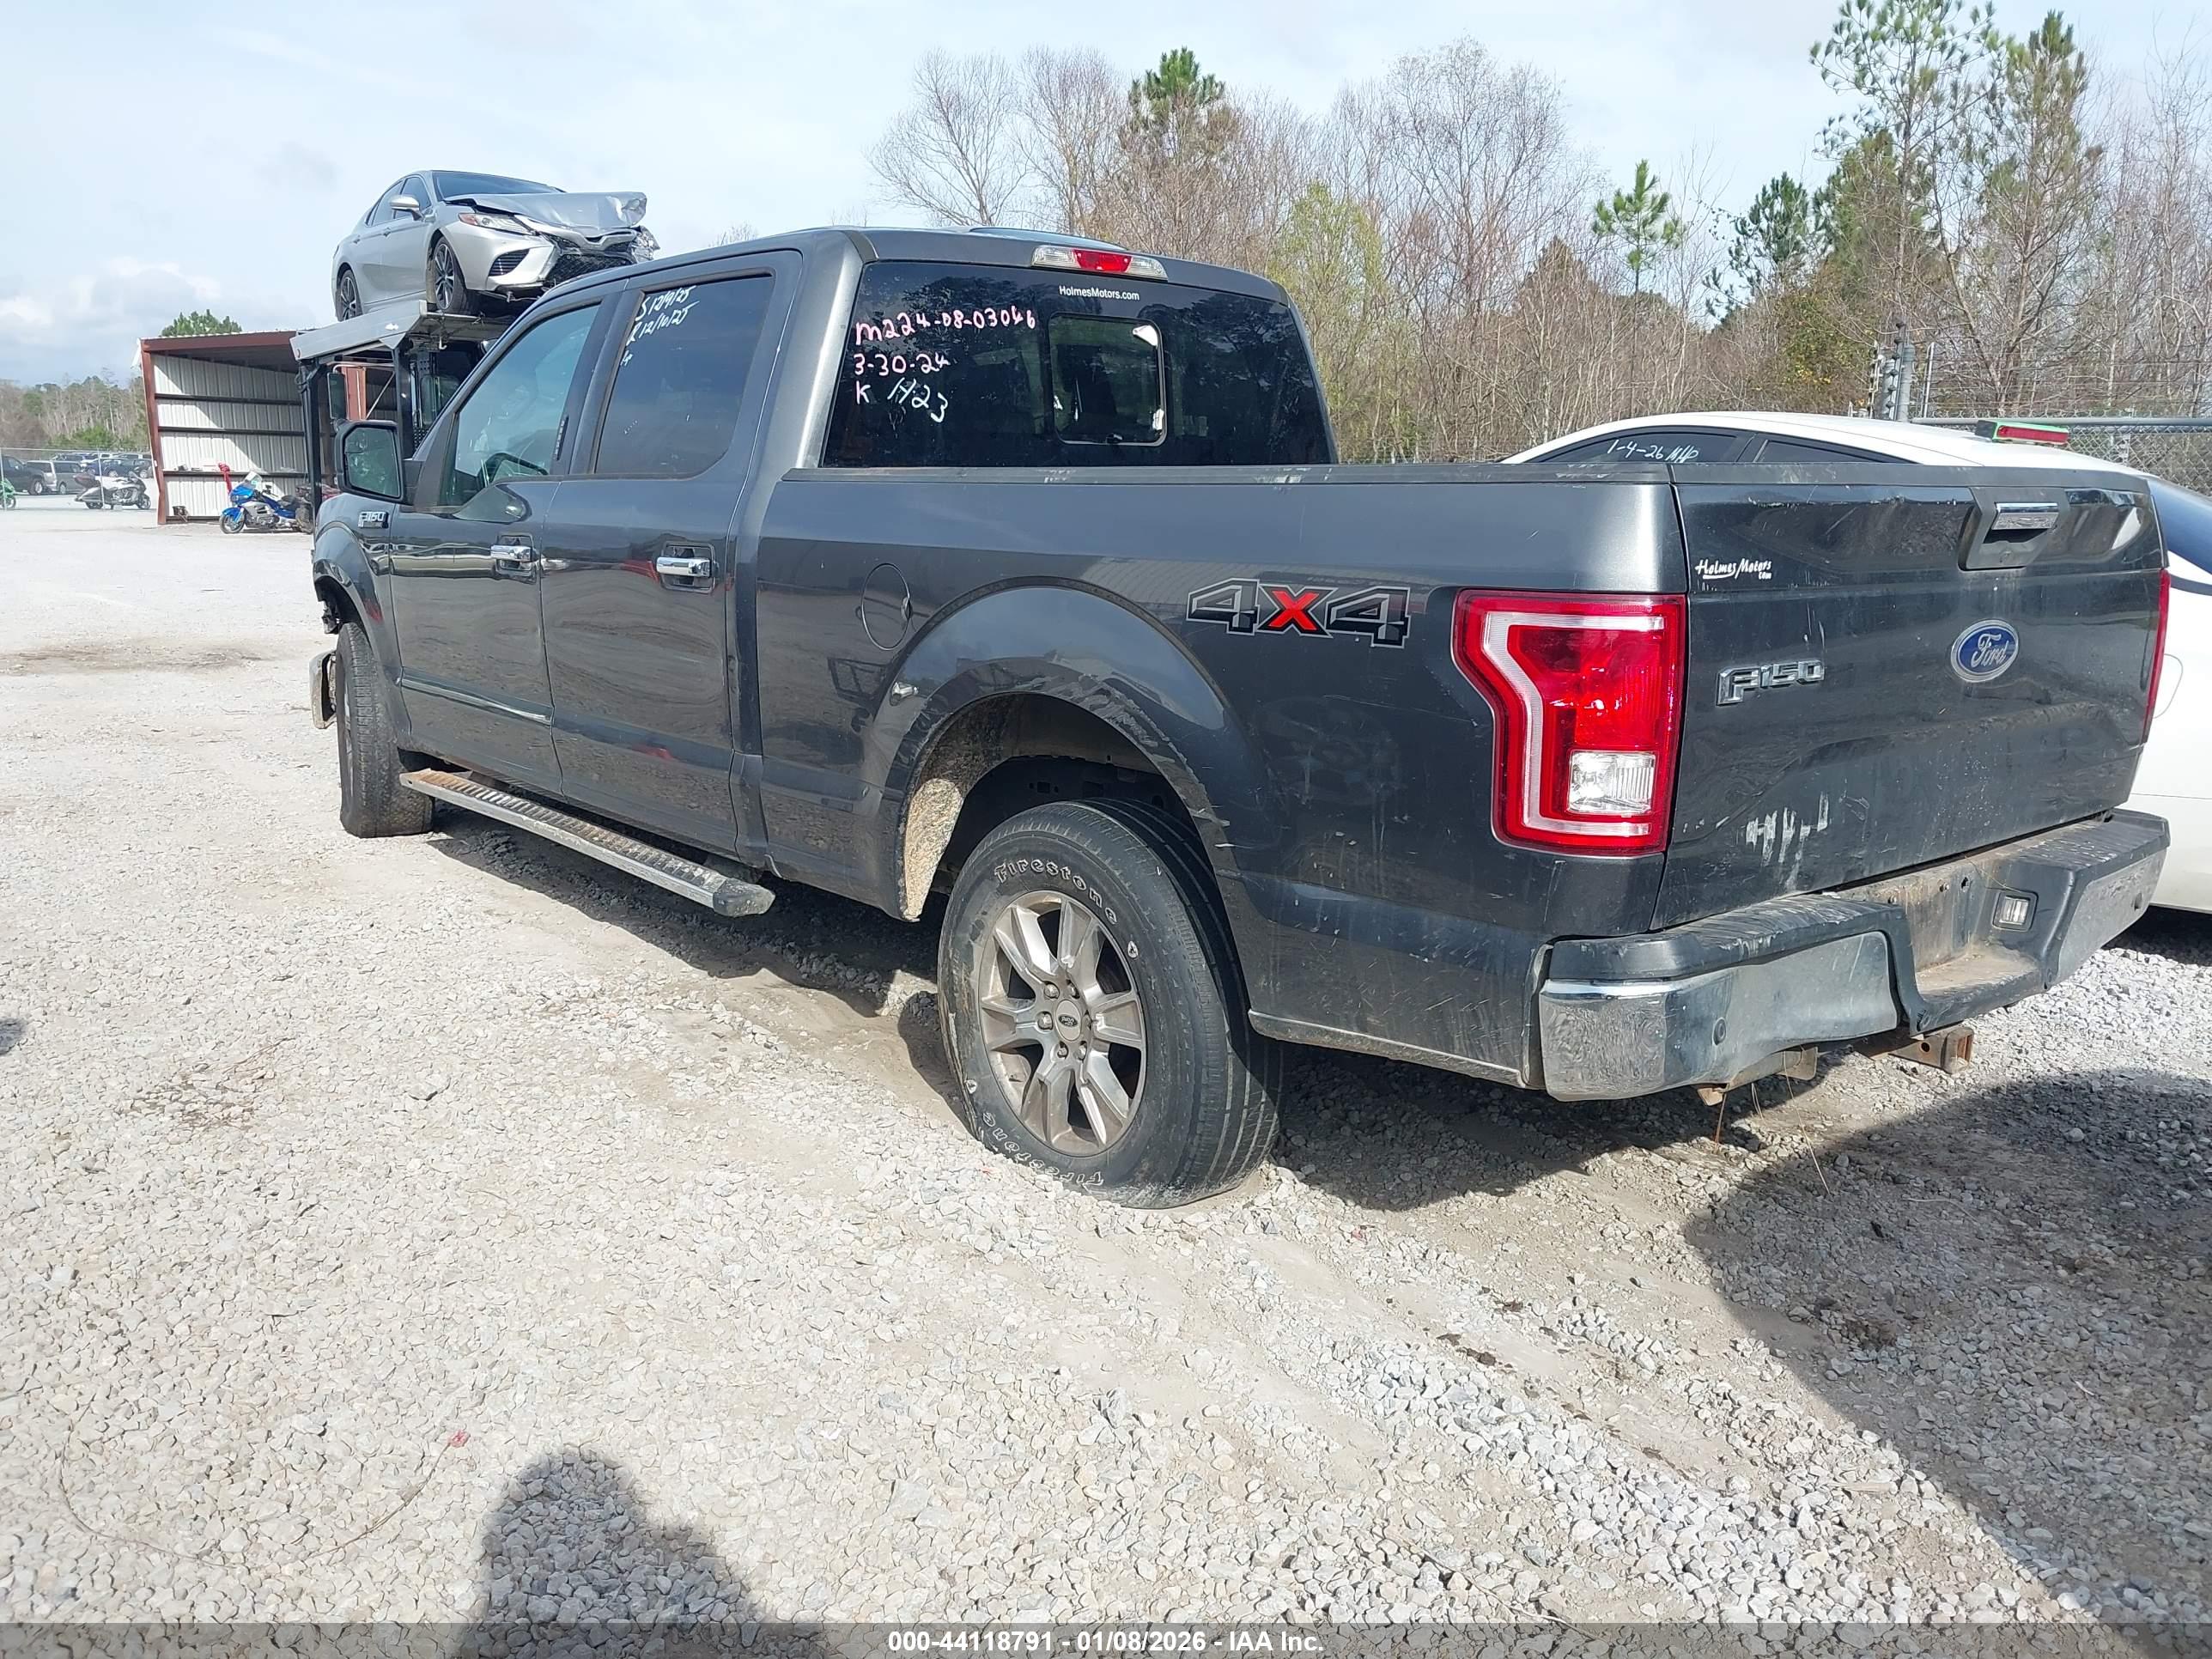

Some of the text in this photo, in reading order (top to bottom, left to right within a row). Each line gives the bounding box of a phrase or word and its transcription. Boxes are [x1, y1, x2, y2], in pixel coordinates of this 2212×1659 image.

[1059, 285, 1139, 301] HolmesMotors.com
[1607, 439, 1664, 459] 1-4-26
[1694, 557, 1772, 580] Holmes Motors
[1971, 633, 2009, 668] Ford
[994, 859, 1117, 926] Firestone
